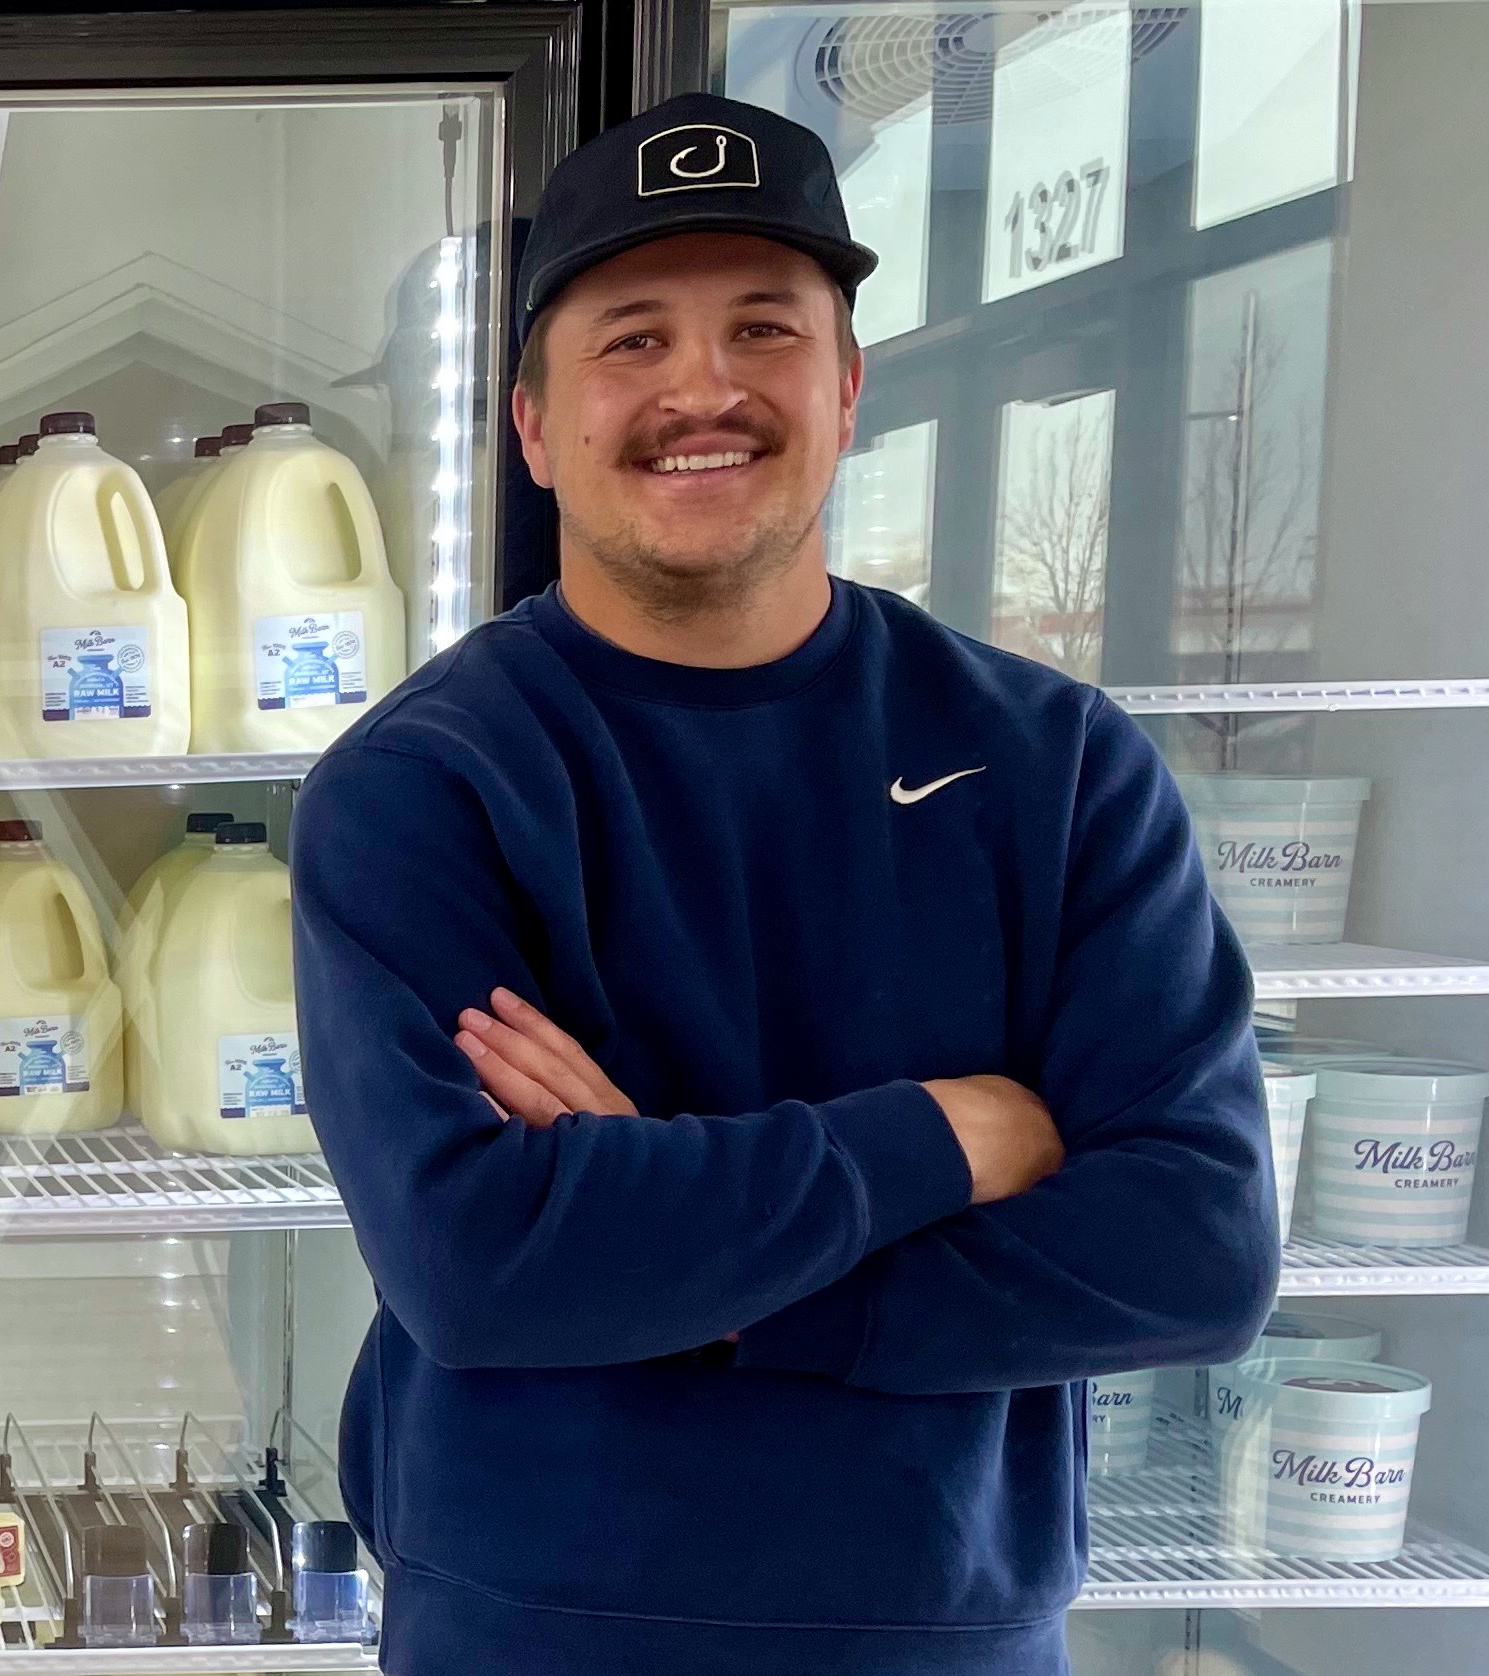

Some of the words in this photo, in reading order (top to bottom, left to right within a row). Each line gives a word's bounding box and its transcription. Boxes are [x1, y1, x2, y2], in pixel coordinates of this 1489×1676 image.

[1004, 157, 1110, 278] 1327
[74, 689, 95, 697] RAW
[97, 688, 119, 696] MILK
[1217, 840, 1278, 873] Milk
[1280, 841, 1342, 871] Barn
[1250, 878, 1316, 888] CREAMERY
[1354, 1139, 1423, 1173] Milk
[1395, 1178, 1459, 1188] CREAMERY
[1273, 1450, 1342, 1486] Milk
[1344, 1457, 1405, 1488] Barn
[1310, 1492, 1381, 1504] CREAMERY
